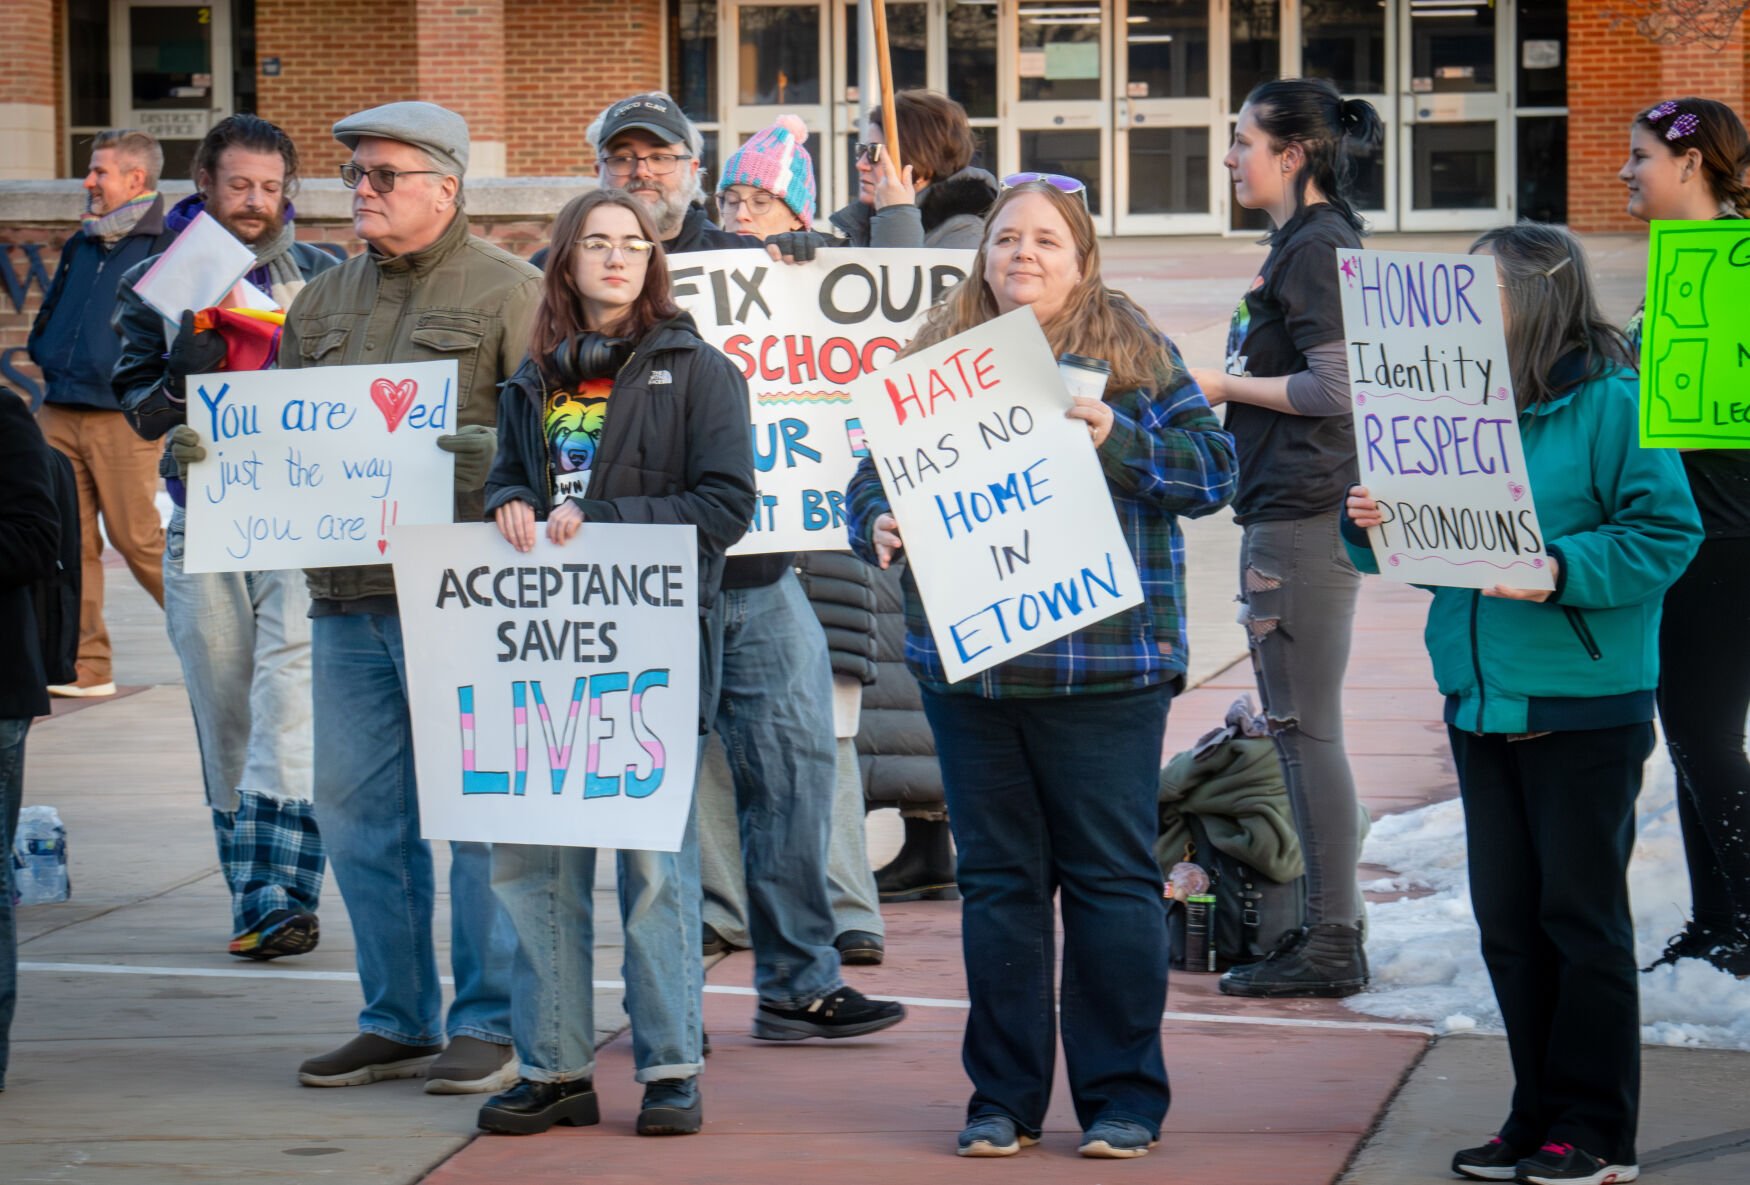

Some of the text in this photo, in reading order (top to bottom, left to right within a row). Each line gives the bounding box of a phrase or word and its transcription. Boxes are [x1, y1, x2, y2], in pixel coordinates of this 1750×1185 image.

[1358, 256, 1482, 328] HONOR
[723, 334, 901, 385] SCHOO
[884, 347, 1001, 425] HATE
[1351, 342, 1492, 405] Identity
[197, 382, 261, 442] You
[280, 399, 357, 432] are
[751, 417, 822, 472] UR
[884, 433, 960, 496] HAS
[978, 406, 1034, 450] NO
[1364, 413, 1513, 476] RESPECT
[206, 446, 393, 504] just the way
[934, 458, 1054, 540] HOME
[226, 515, 302, 560] you
[801, 489, 849, 531] BR
[1374, 500, 1542, 556] PRONOUNS
[990, 529, 1031, 581] IN
[435, 563, 684, 609] ACCEPTANCE
[949, 552, 1123, 664] ETOWN
[497, 619, 618, 663] SAVES
[457, 668, 671, 800] LIVES
